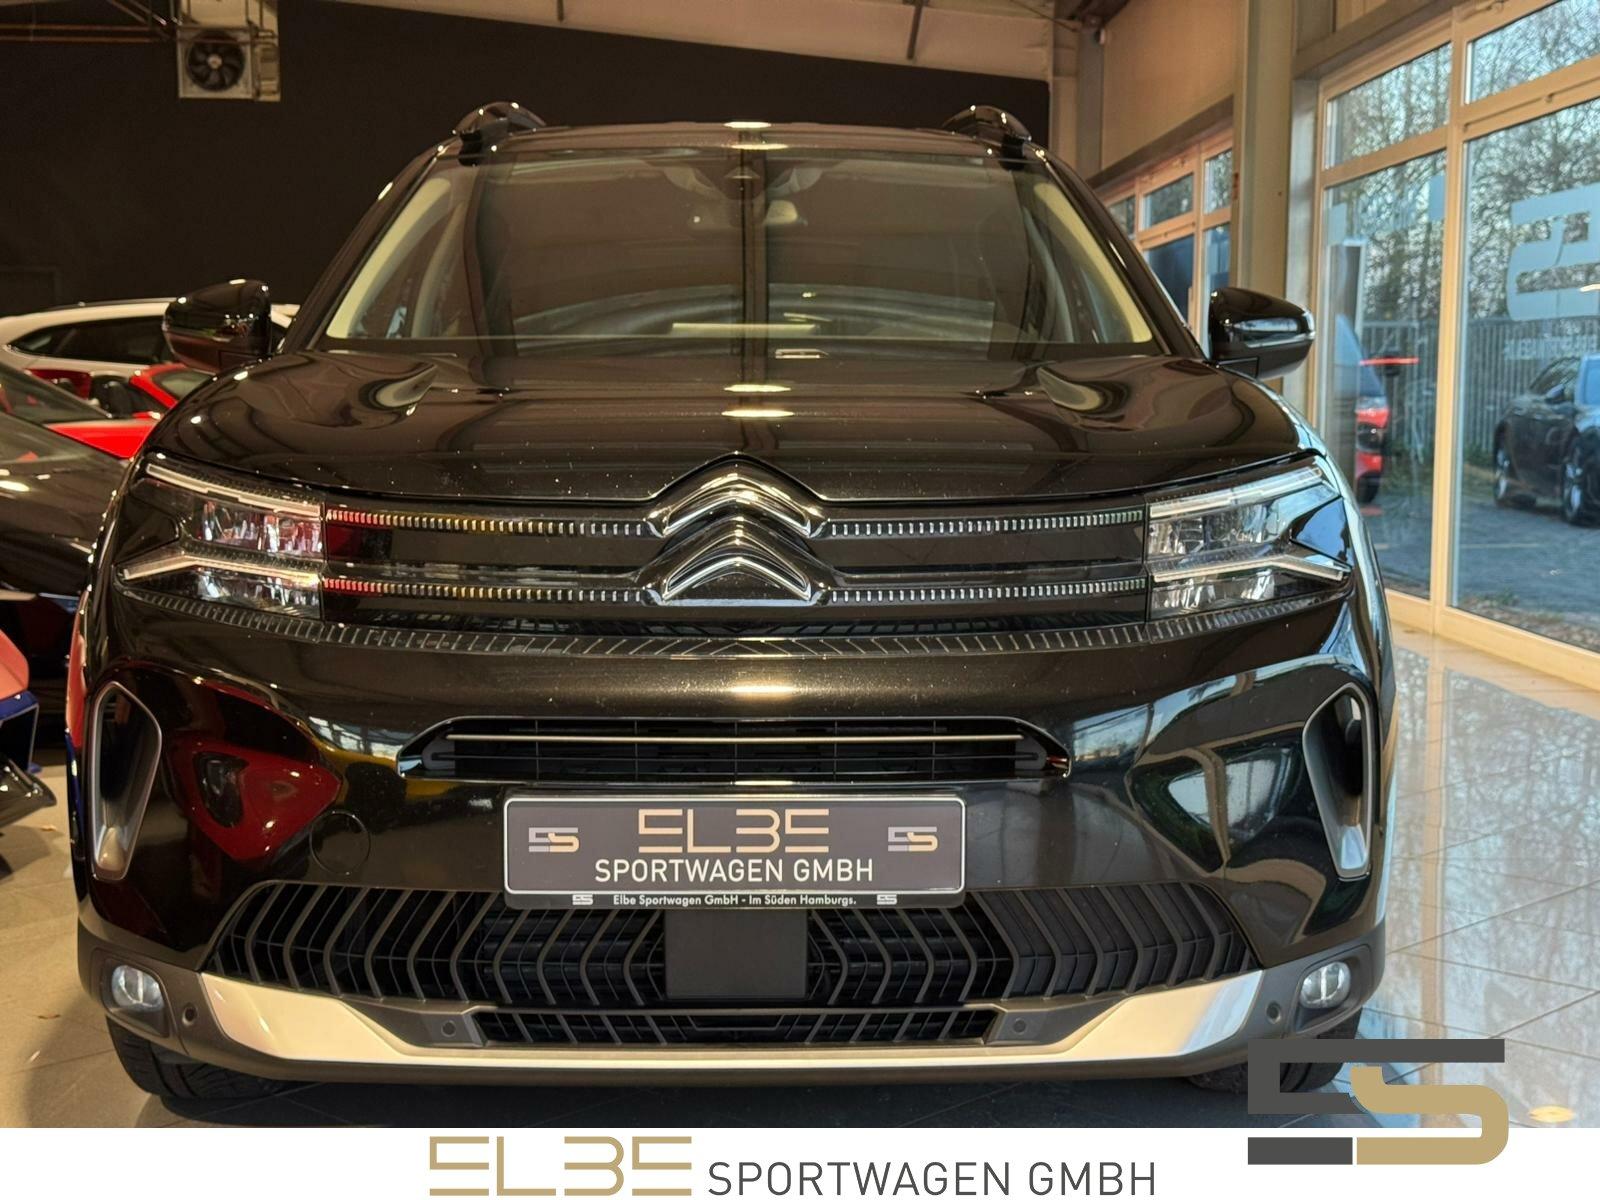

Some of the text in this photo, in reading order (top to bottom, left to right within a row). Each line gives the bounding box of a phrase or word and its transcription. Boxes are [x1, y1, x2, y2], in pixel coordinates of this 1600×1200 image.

[638, 808, 830, 853] ELBE
[594, 858, 873, 883] SPORTWAGEN GMBH
[613, 894, 636, 905] Elbe
[639, 894, 701, 907] Sportwagen
[704, 894, 738, 905] GmbH
[749, 895, 762, 905] Im
[764, 894, 797, 905] Süden
[799, 894, 857, 907] Hamburgs.
